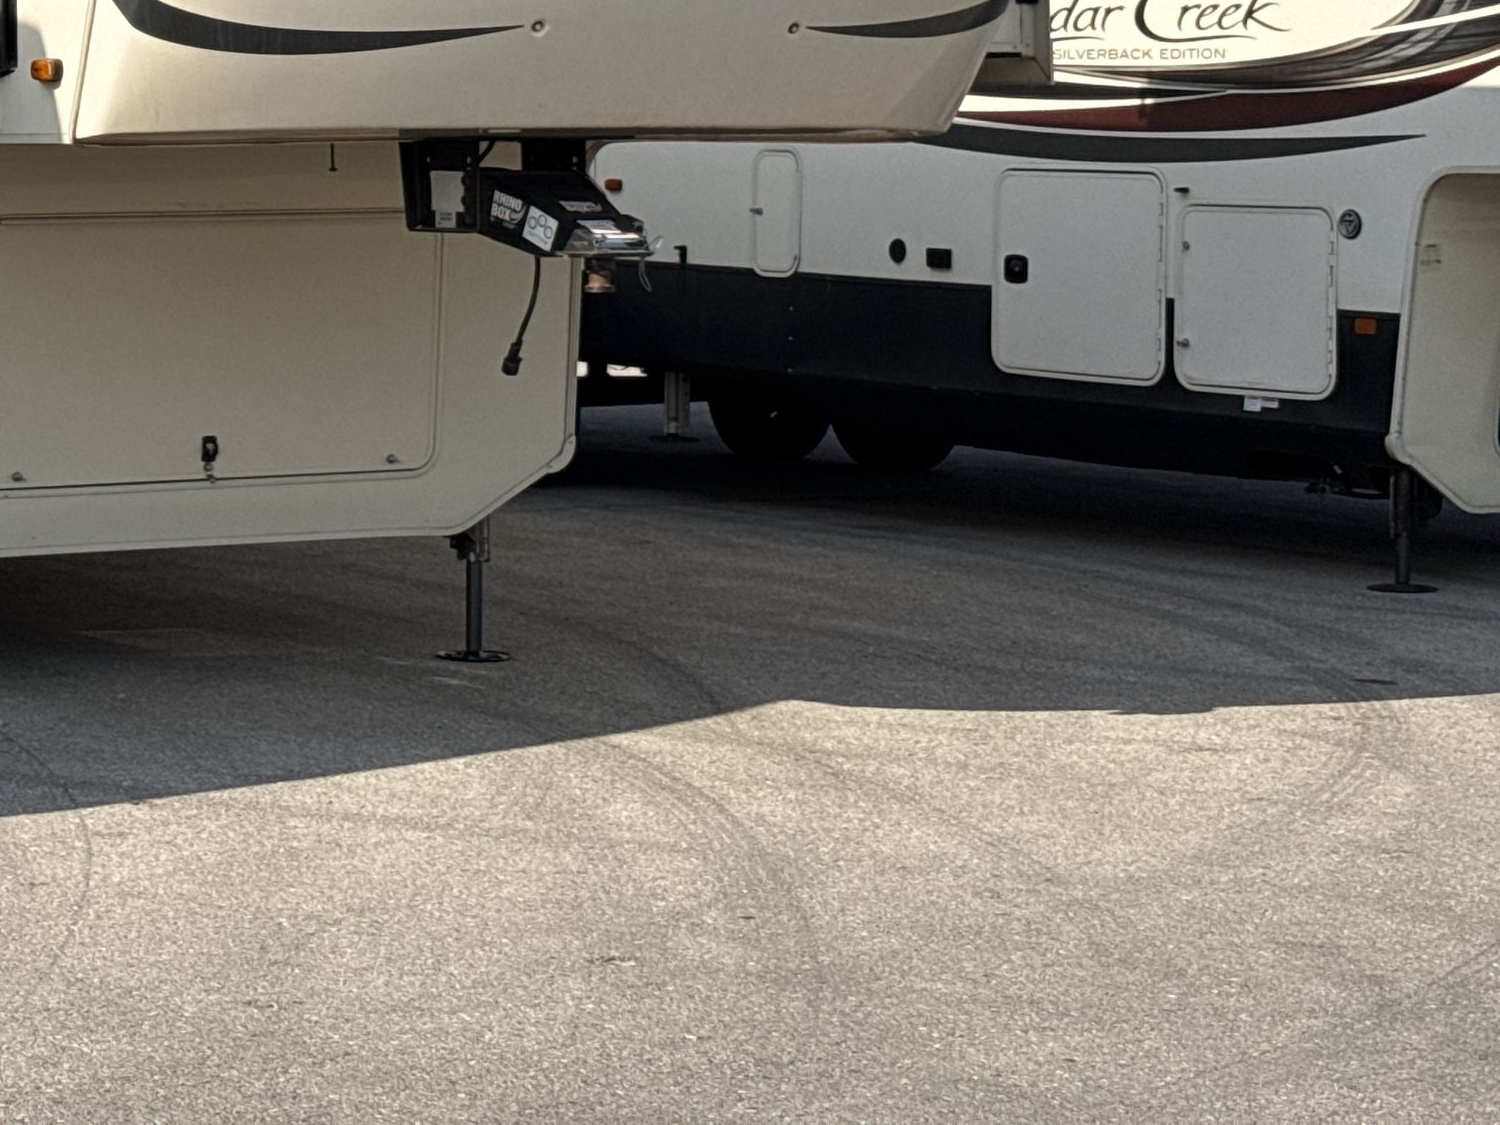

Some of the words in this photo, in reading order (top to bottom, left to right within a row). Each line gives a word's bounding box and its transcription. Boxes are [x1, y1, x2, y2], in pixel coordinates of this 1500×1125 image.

[1052, 48, 1153, 61] SILVERBACK
[1159, 48, 1226, 60] EDITION
[493, 189, 523, 213] RHINO
[491, 202, 511, 223] BOX
